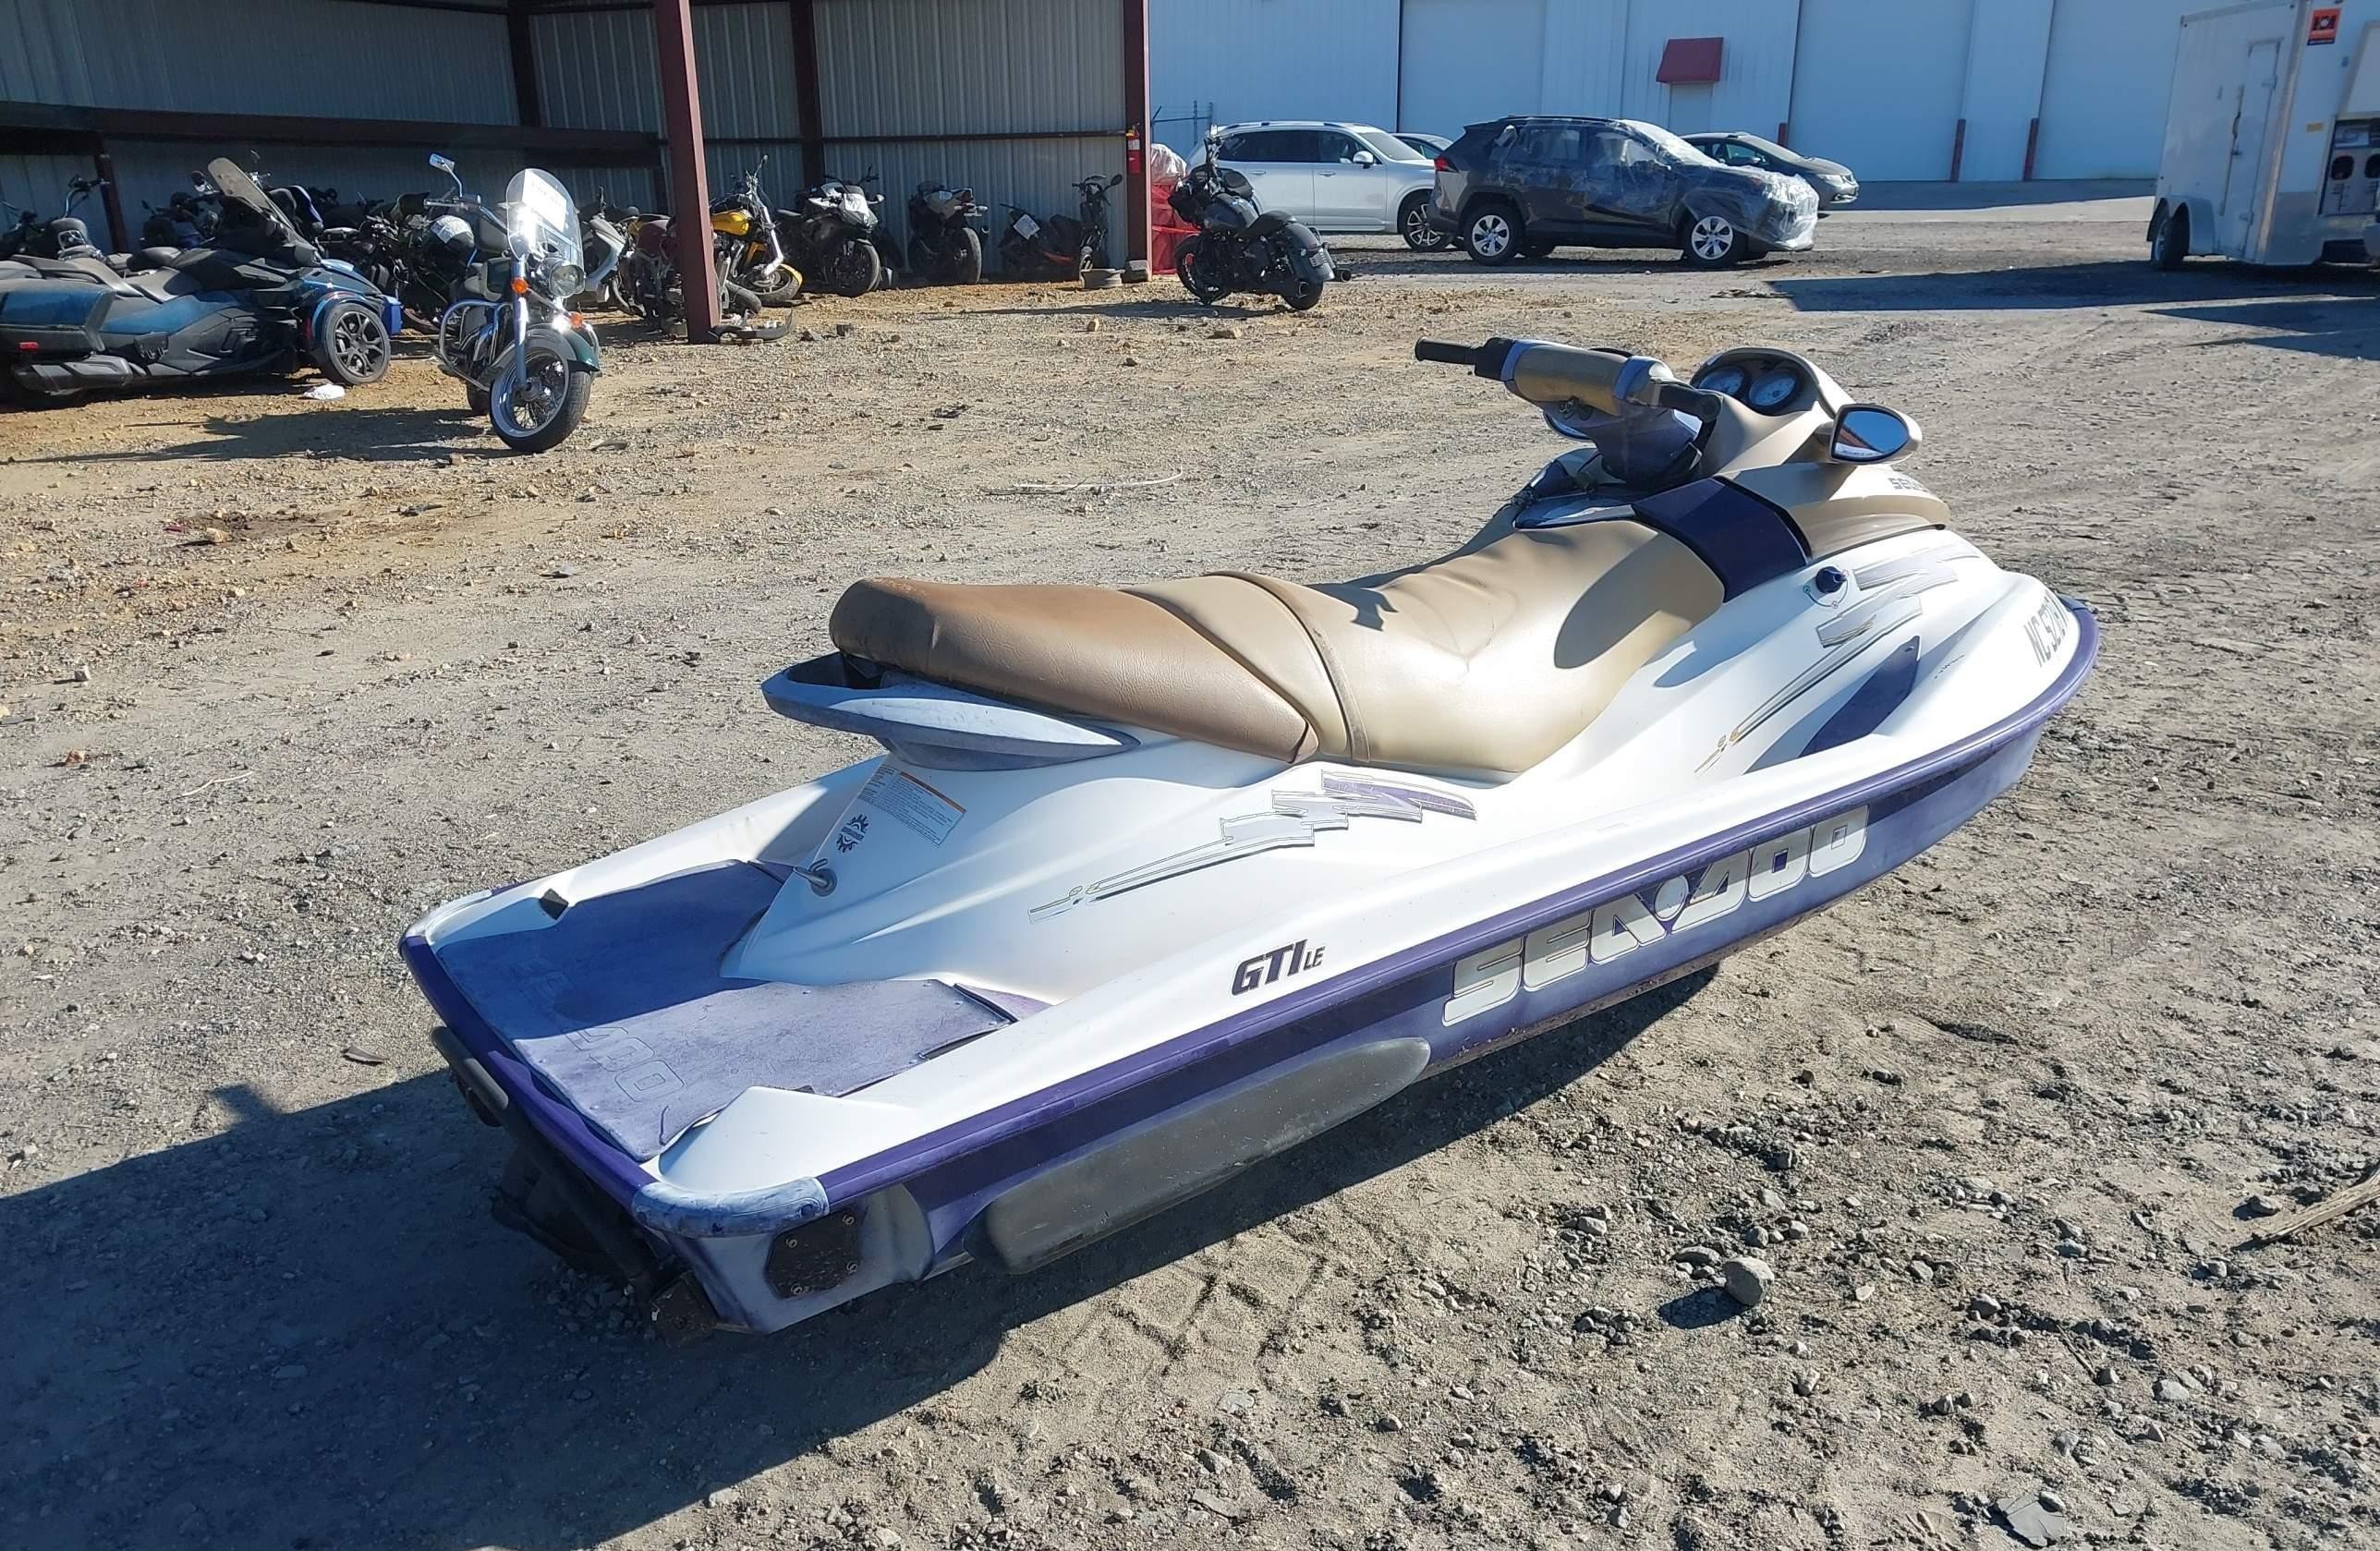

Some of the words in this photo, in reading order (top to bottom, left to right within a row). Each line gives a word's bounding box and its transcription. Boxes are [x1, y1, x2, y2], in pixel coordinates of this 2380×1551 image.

[2023, 614, 2051, 668] NC
[1231, 939, 1307, 997] GTI
[1303, 945, 1326, 971] LE
